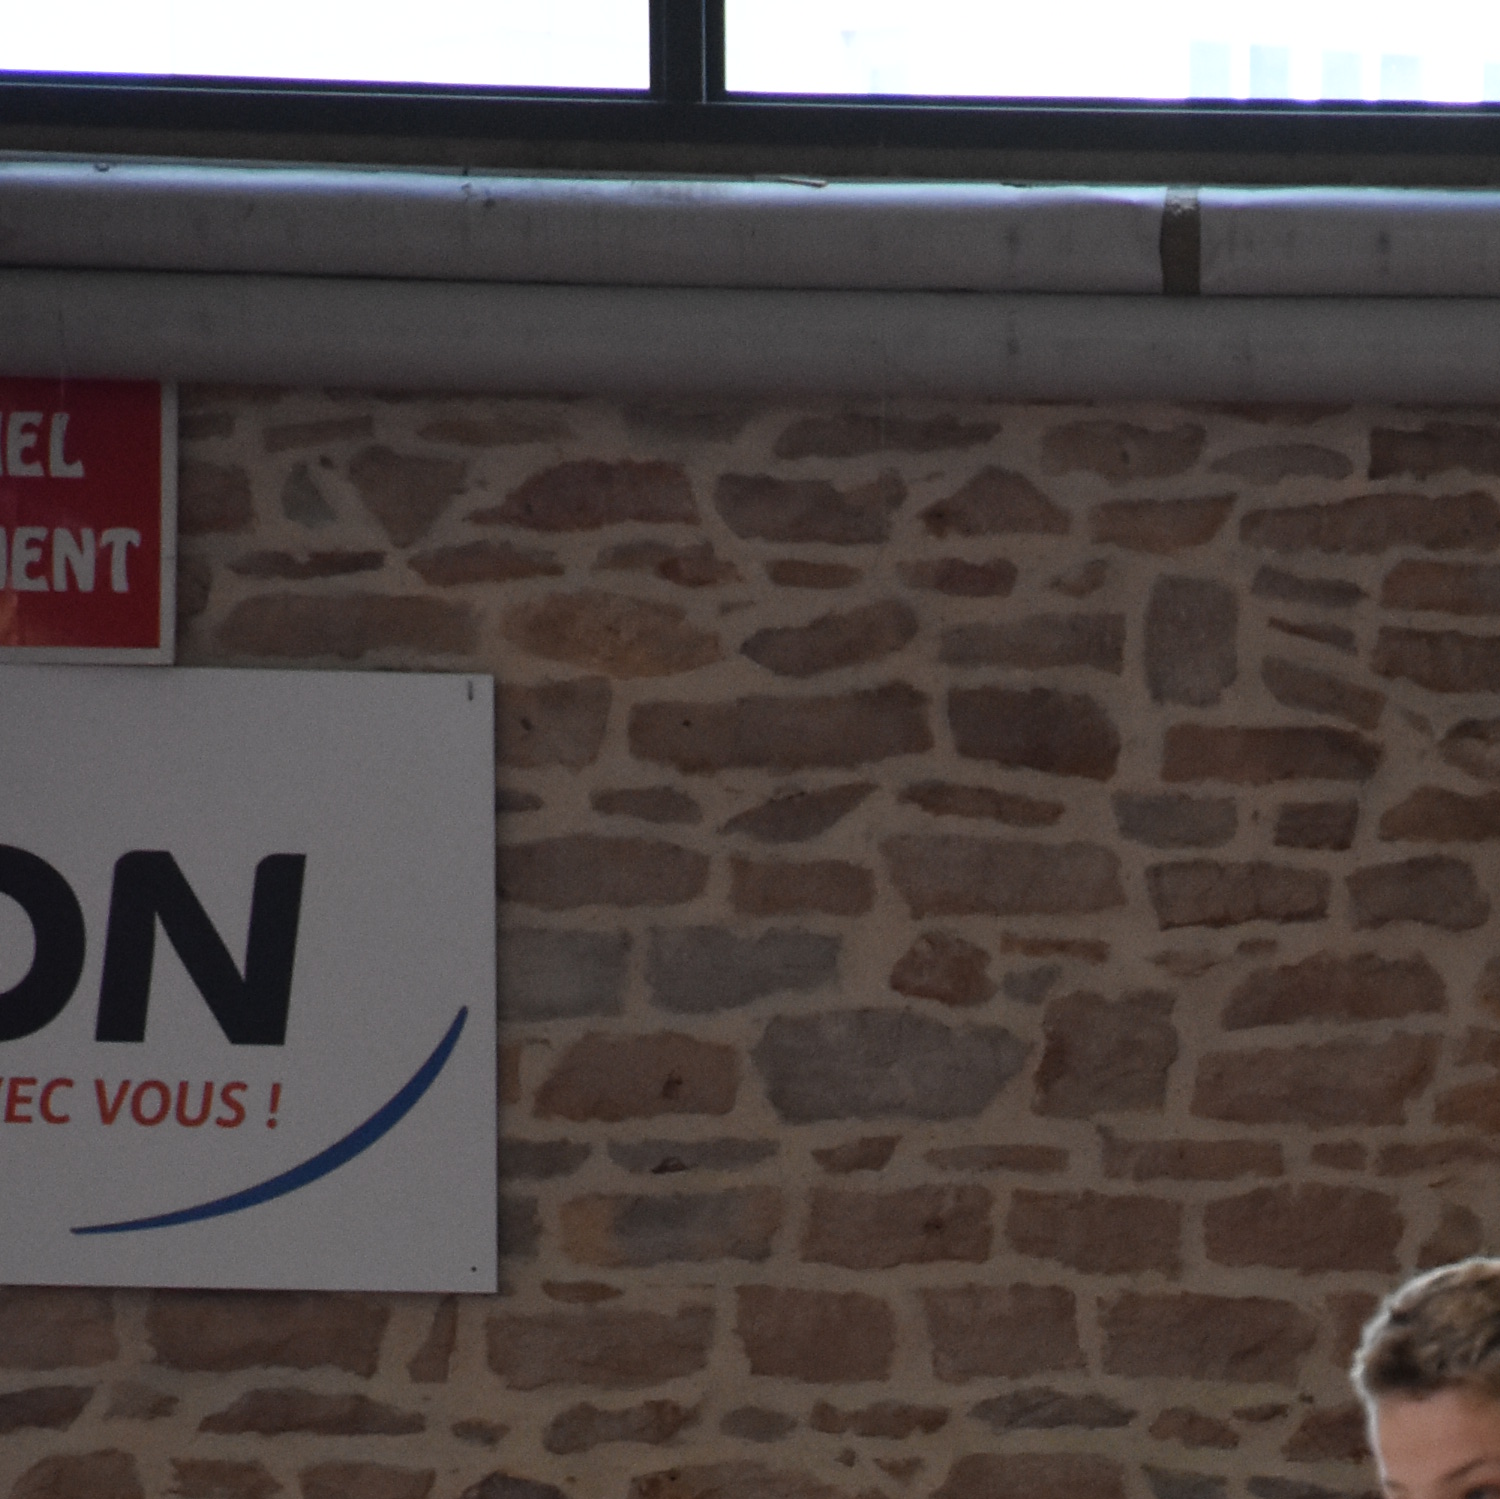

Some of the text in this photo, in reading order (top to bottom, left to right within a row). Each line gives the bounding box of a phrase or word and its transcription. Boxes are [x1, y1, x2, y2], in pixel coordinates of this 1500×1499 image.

[0, 411, 85, 478] EL
[0, 526, 142, 593] ENT
[0, 1076, 74, 1124] EC
[94, 1078, 248, 1128] VOUS
